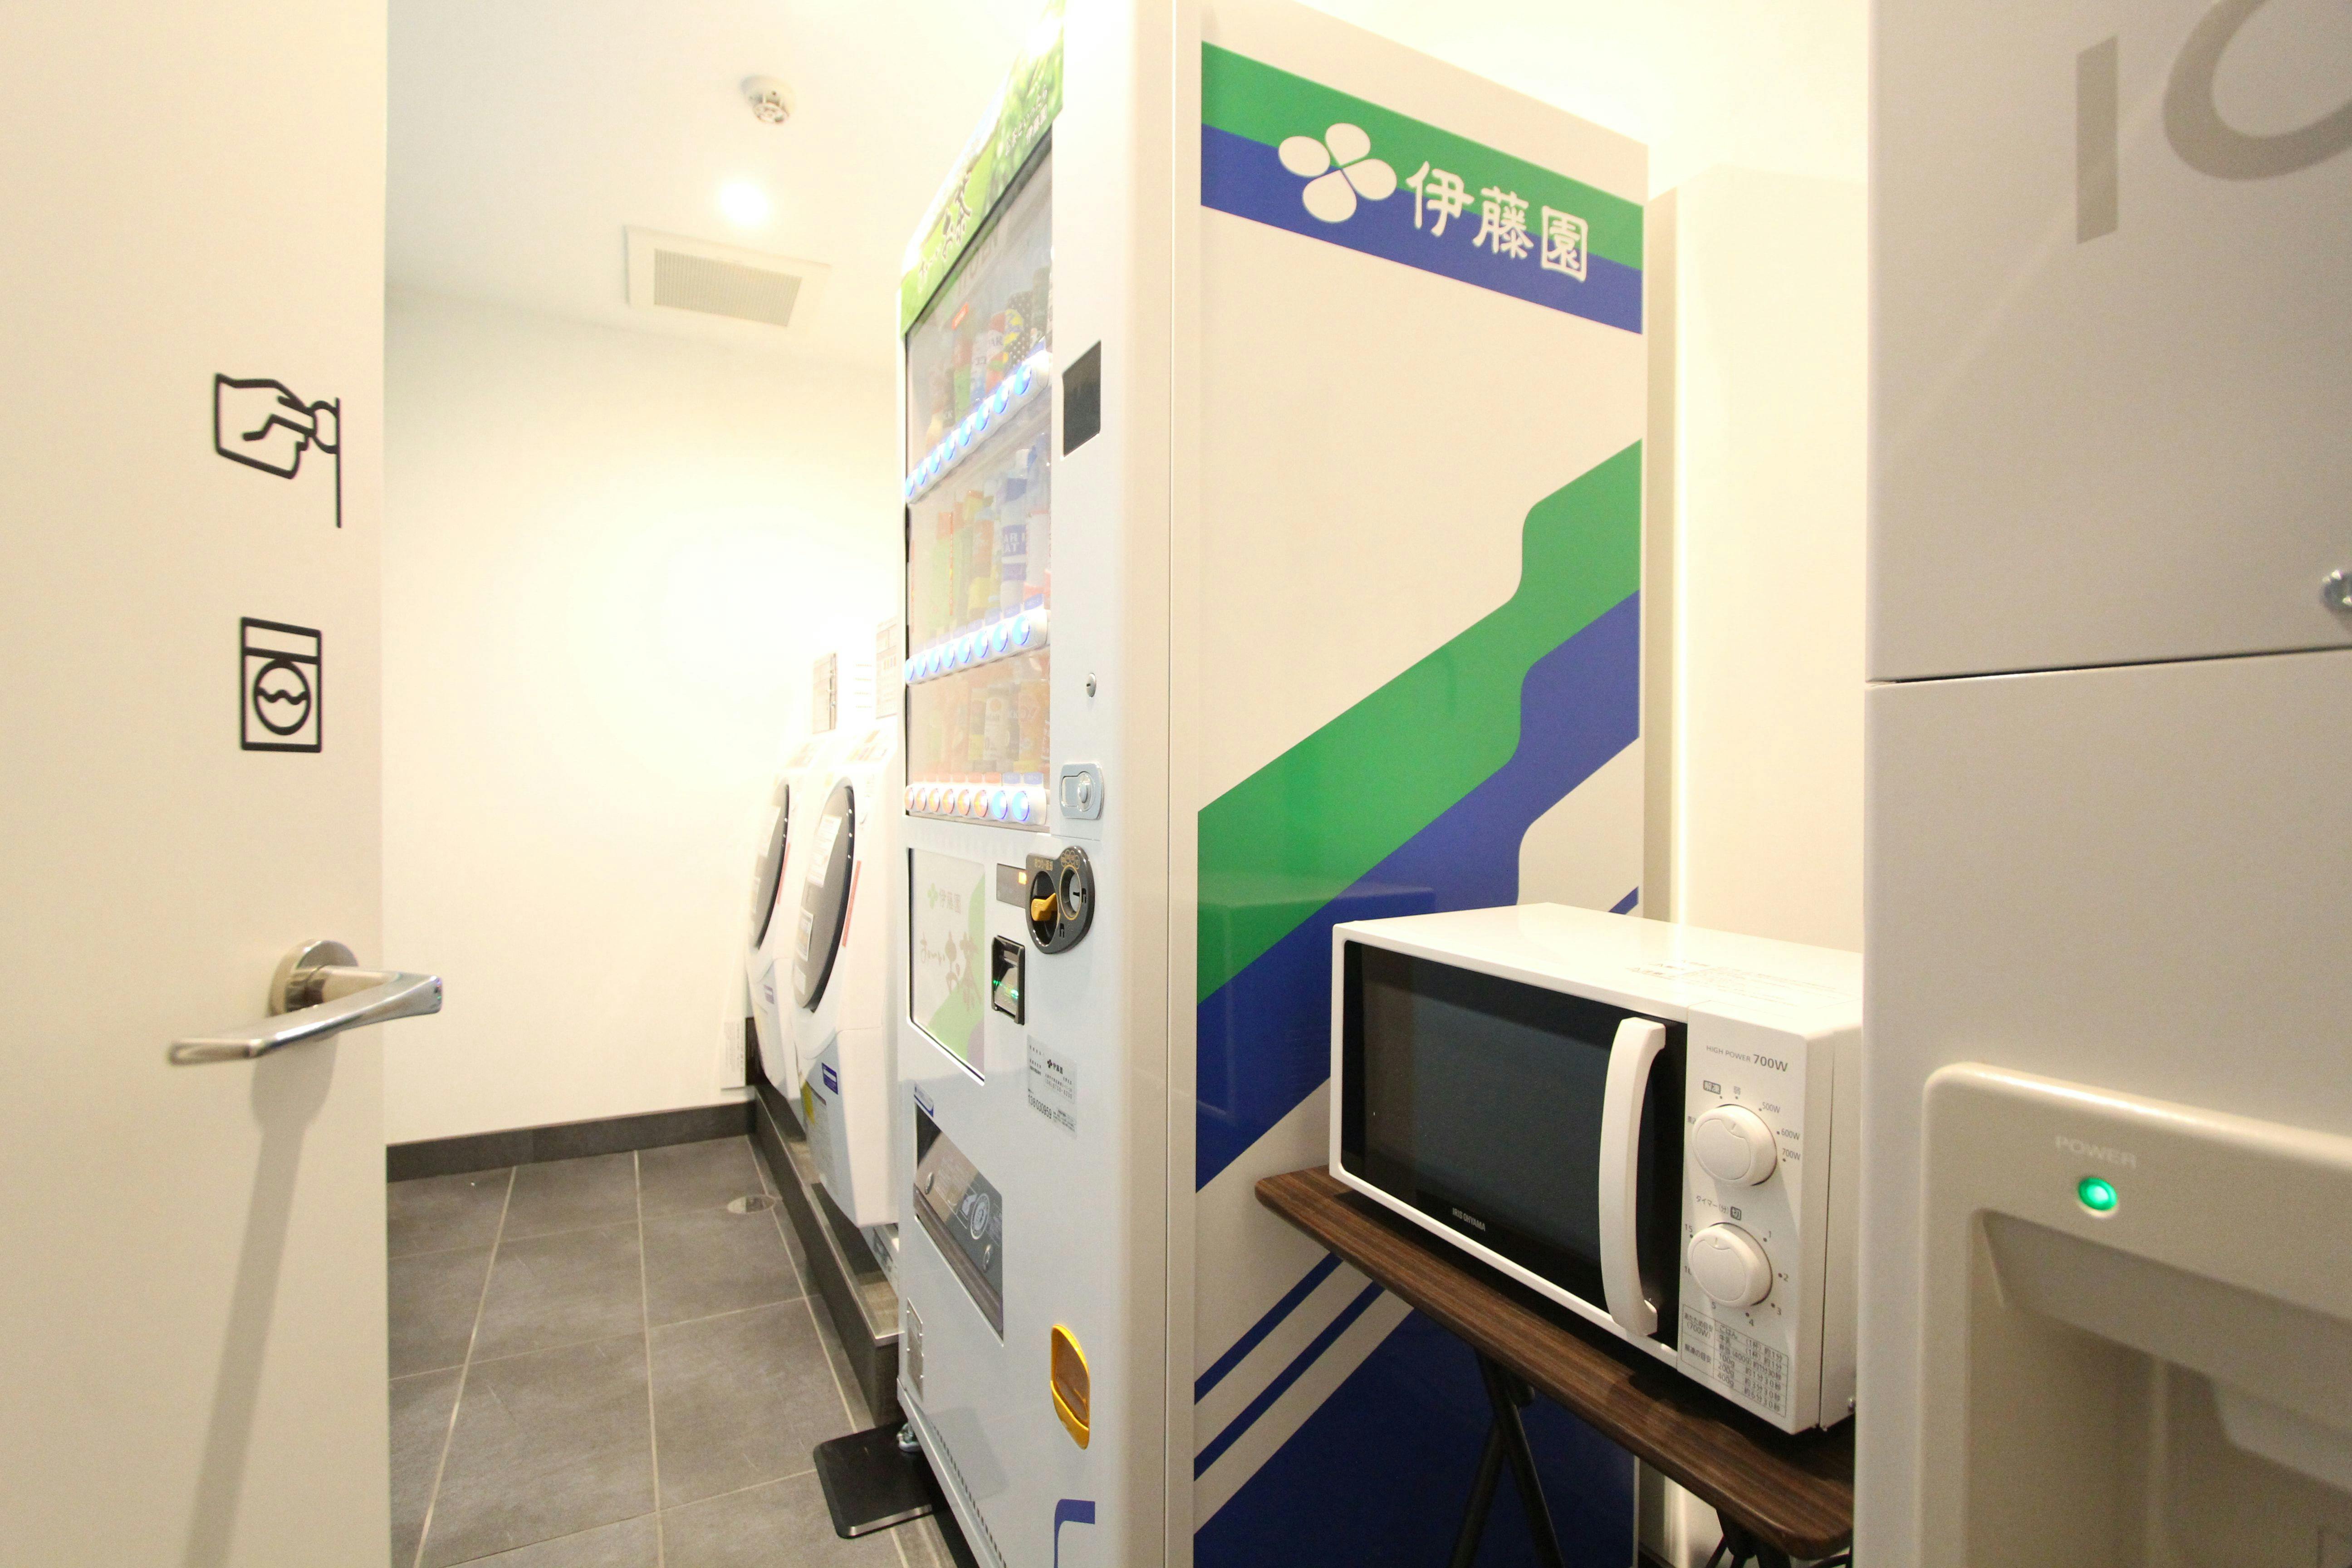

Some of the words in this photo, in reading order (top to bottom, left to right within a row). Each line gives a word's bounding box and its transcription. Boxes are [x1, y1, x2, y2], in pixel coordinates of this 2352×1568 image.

[1406, 161, 1588, 282] 伊藤園
[1706, 1045, 1724, 1055] HIGH
[1725, 1050, 1751, 1063] POWER
[1753, 1054, 1788, 1072] 700W
[1762, 1102, 1780, 1114] 500W
[1781, 1128, 1800, 1141] 600W
[1782, 1148, 1801, 1161] 700W
[2054, 1135, 2137, 1169] POWER
[1452, 1207, 1463, 1220] IRIS
[1684, 1224, 1693, 1233] 15
[1783, 1273, 1788, 1282] 2
[1711, 1302, 1716, 1310] 5
[1776, 1308, 1782, 1316] 3
[1748, 1318, 1754, 1327] 4
